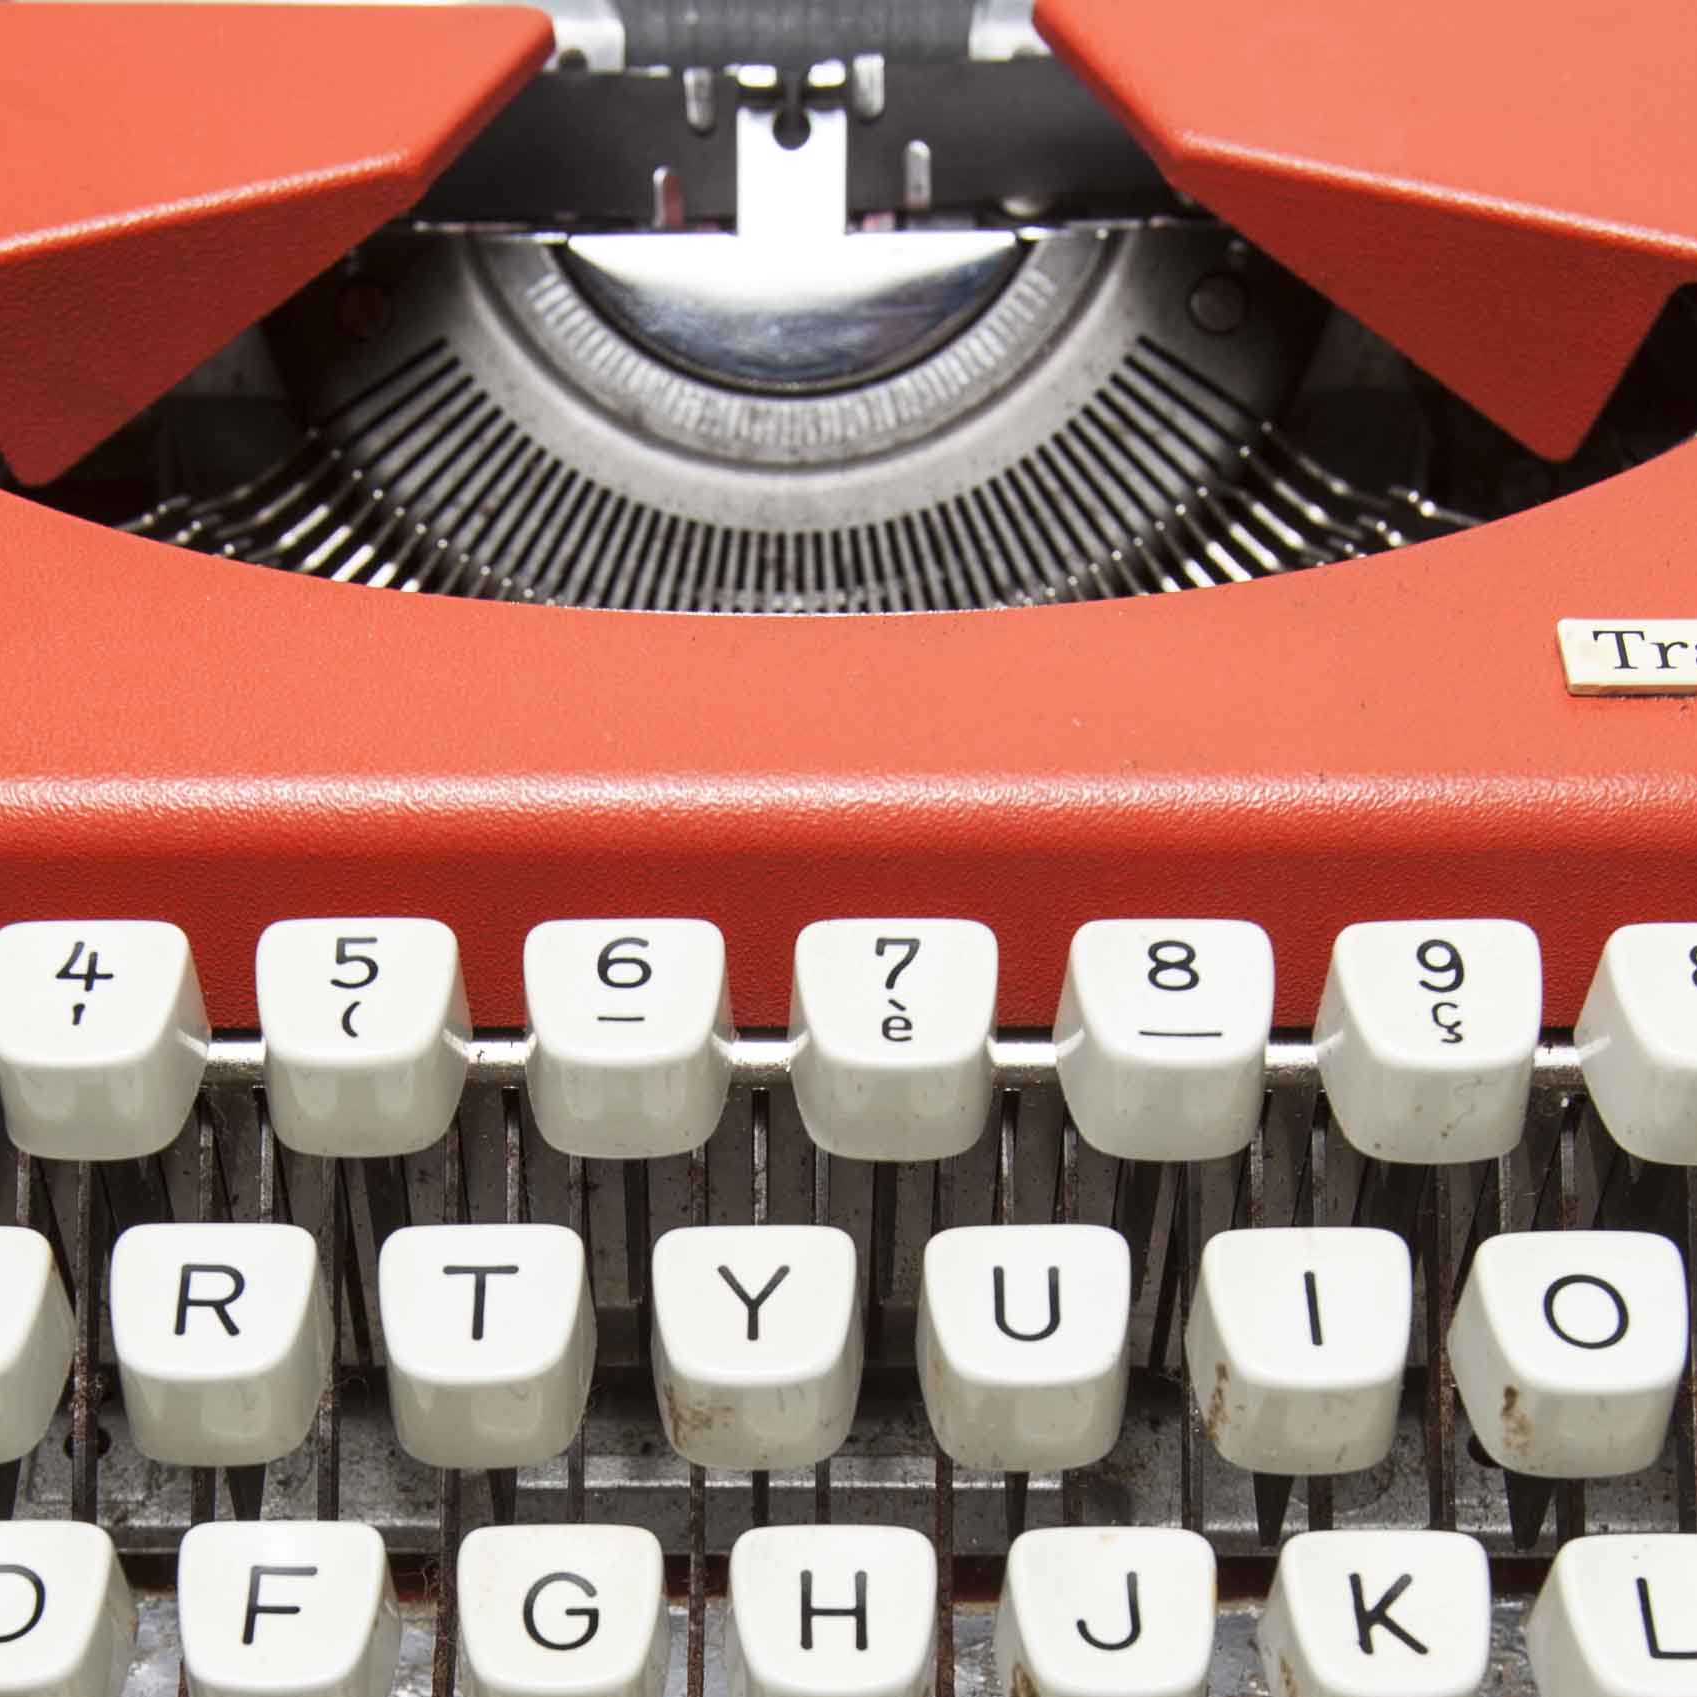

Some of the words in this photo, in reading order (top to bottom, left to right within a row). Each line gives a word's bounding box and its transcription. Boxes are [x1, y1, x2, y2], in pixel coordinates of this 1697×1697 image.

[54, 940, 115, 993] 4
[329, 936, 380, 990] 5
[596, 936, 653, 990] 6
[874, 936, 921, 991] 7
[1146, 939, 1201, 993] 8
[1415, 938, 1466, 994] 9
[880, 998, 914, 1043] è
[1430, 1001, 1465, 1045] ç
[173, 1262, 246, 1338] R
[441, 1264, 521, 1342] T
[716, 1264, 791, 1342] Y
[992, 1265, 1062, 1343] U
[1302, 1270, 1324, 1348] I
[1542, 1273, 1631, 1351] O
[241, 1564, 319, 1647] F
[521, 1571, 601, 1652] G
[799, 1569, 869, 1653] H
[1075, 1570, 1143, 1653] J
[1348, 1571, 1430, 1656] K
